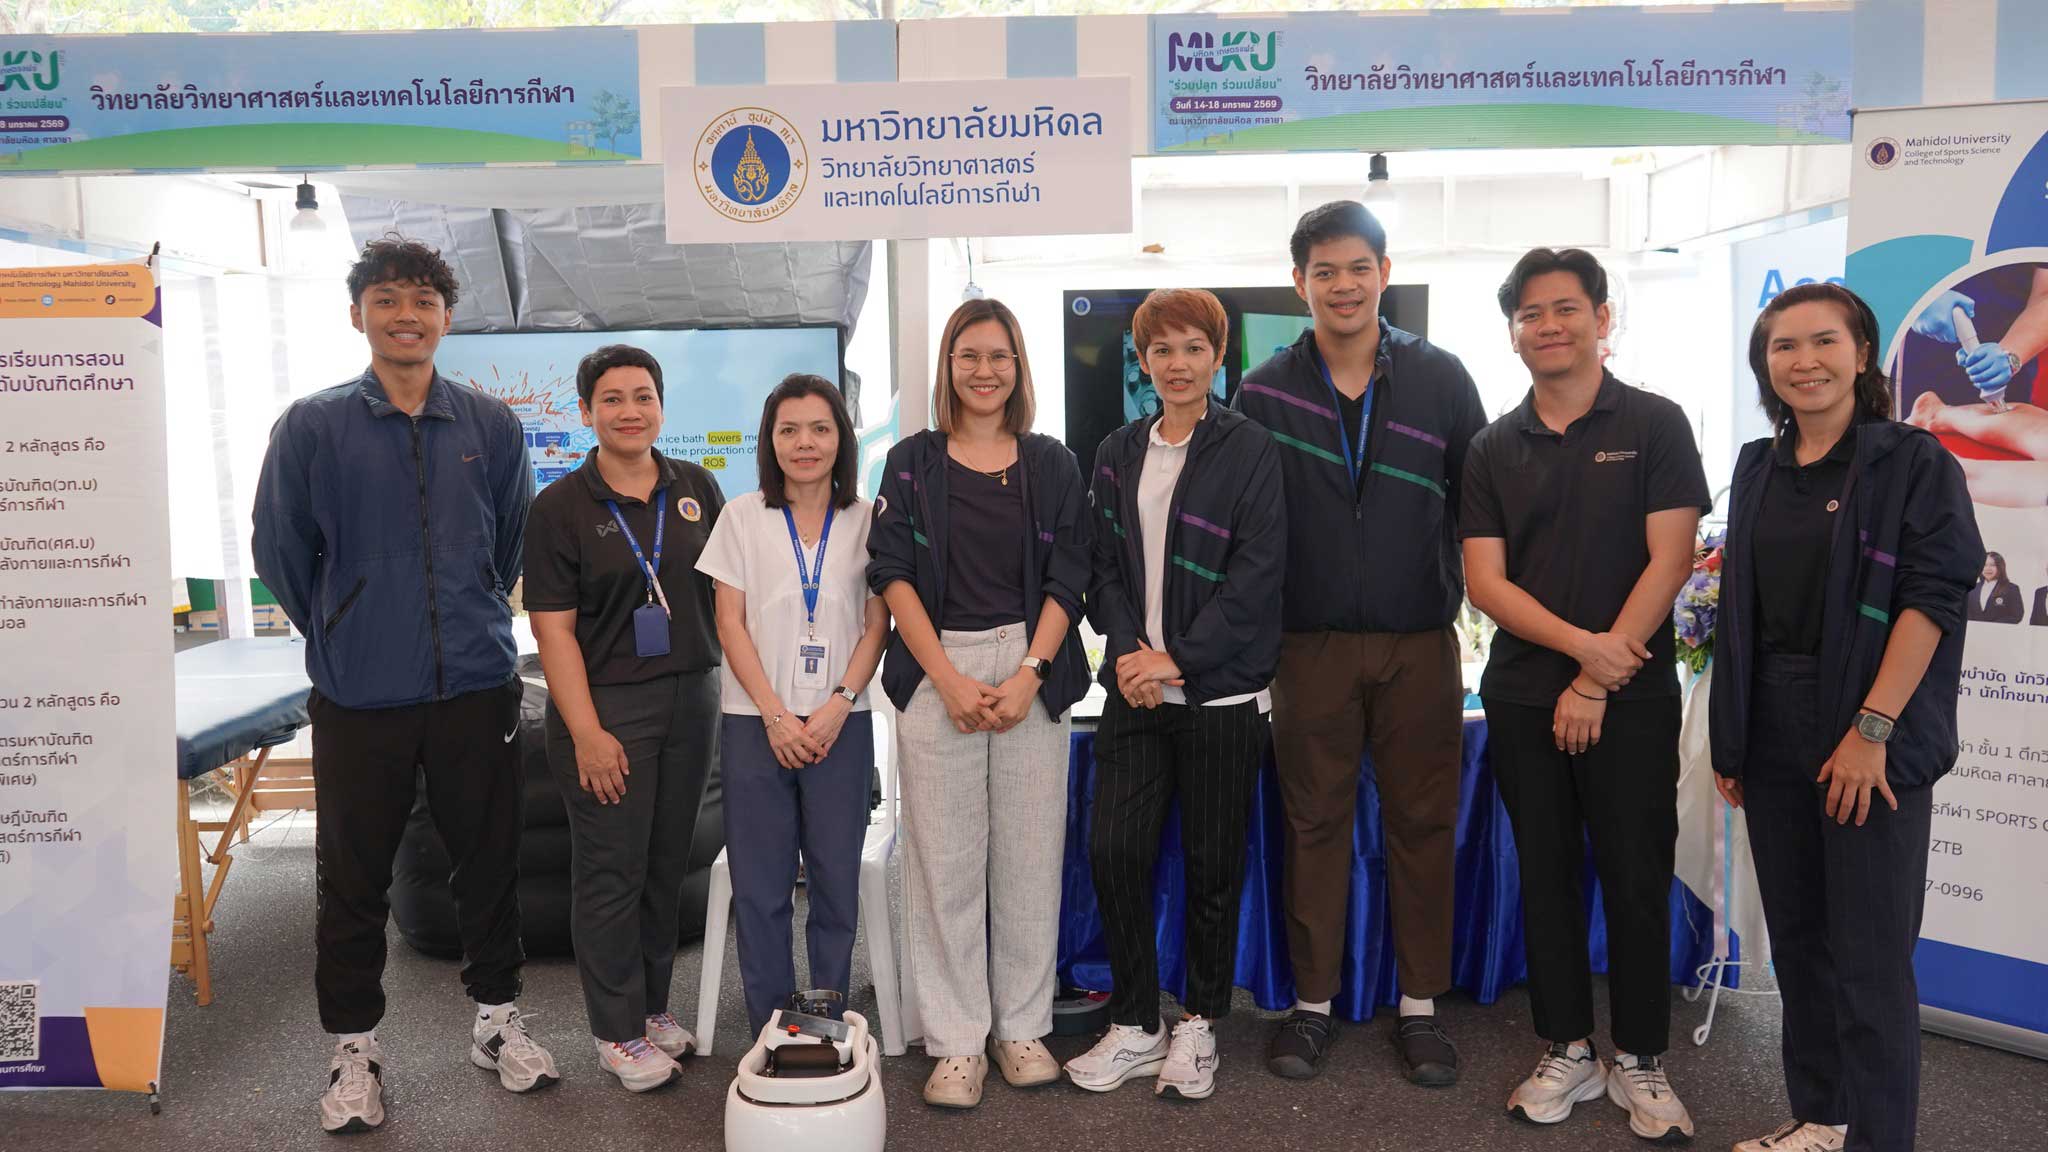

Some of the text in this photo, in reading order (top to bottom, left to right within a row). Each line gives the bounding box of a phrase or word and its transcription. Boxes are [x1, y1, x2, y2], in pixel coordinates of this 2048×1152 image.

[0, 50, 59, 91] KU
[1305, 59, 1786, 91] วิทยาลัยวิทยาศาสตร์และเทคโนโลยีการกีฬา
[90, 77, 575, 110] วิทยาลัยวิทยาศาสตร์และเทคโนโลยีการกีฬา
[1176, 99, 1277, 110] วันที่ 14-18 มกราคม 2569
[8, 121, 38, 129] มกราคม
[40, 119, 64, 129] 2569
[820, 103, 1103, 143] มหาวิทยาลัยมหิดล
[1181, 115, 1251, 125] มหาวิทยาลัยมหิดล
[1905, 133, 2011, 147] Mahidol University
[1904, 149, 1933, 158] College
[1943, 147, 1969, 158] Sports
[1970, 147, 2001, 155] Science
[821, 150, 1035, 180] วิทยาลัยวิทยาศาสตร์
[1920, 157, 1964, 166] Technology
[824, 181, 1041, 208] และเทคโนโลยีการกีฬา
[96, 280, 136, 288] University
[665, 435, 680, 444] ice
[682, 434, 705, 443] bath
[708, 432, 741, 443] lowers
[6, 437, 105, 456] 2 หลักสูตร คือ
[671, 447, 687, 456] the
[690, 445, 745, 457] production
[747, 445, 757, 454] of
[703, 457, 729, 467] ROS.
[0, 537, 95, 551] บัณฑิต(ศศ.บ)
[0, 554, 131, 570] ลังกายและการกีฬา
[2015, 671, 2048, 686] นักวิ
[23, 696, 32, 708] 2
[37, 694, 96, 711] หลักสูตร
[100, 692, 121, 706] คือ
[1980, 686, 2048, 703] นักโภชนา
[1978, 738, 1998, 757] ชั้น
[2004, 747, 2013, 759] 1
[2007, 773, 2048, 787] ศาลา
[1976, 809, 2037, 830] SPORTS
